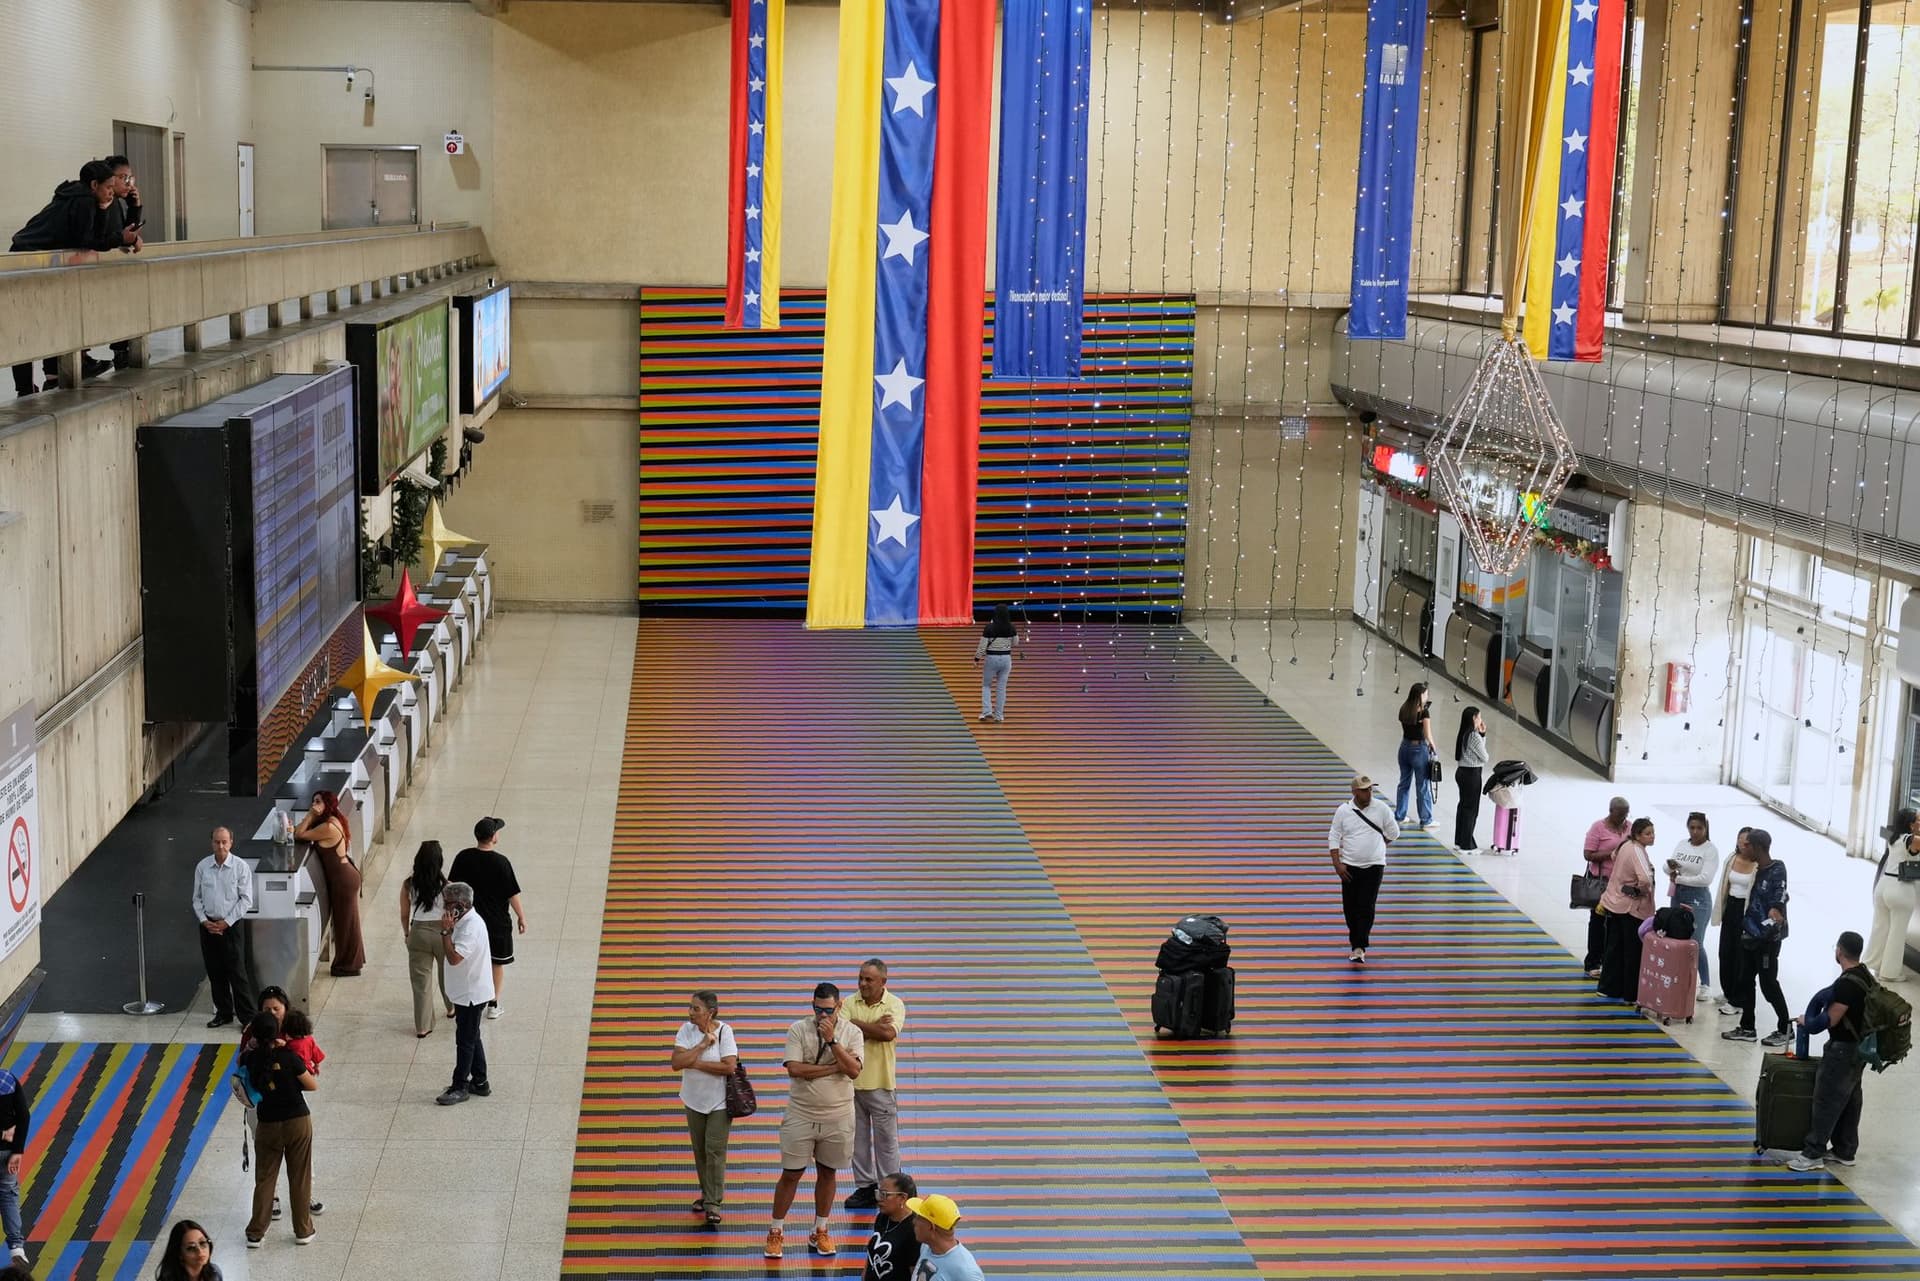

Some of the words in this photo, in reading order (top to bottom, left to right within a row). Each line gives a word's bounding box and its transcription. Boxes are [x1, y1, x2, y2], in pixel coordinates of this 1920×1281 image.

[17, 763, 33, 784] AMBIENTE
[5, 803, 16, 820] HUMO
[16, 799, 21, 811] DE
[21, 787, 34, 805] TABACO
[7, 791, 16, 805] 100%
[16, 781, 27, 798] LIBRE
